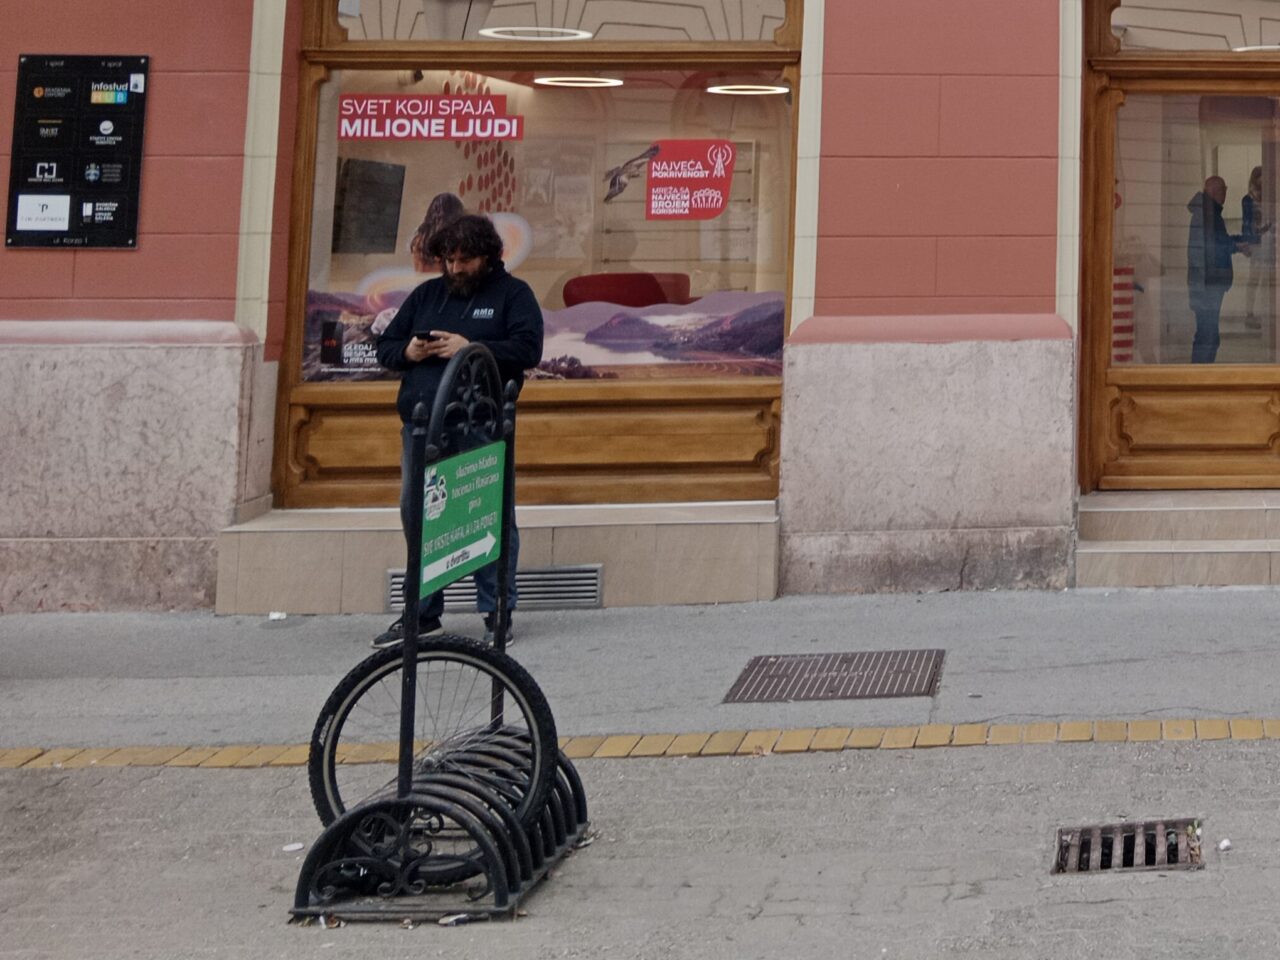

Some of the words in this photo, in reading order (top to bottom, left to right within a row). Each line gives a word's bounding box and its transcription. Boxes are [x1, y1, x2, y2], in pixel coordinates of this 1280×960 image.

[341, 99, 391, 116] SVET
[395, 99, 433, 116] KOJI
[438, 99, 495, 116] SPAJA
[340, 118, 445, 137] MILIONE
[451, 118, 518, 137] LJUDI
